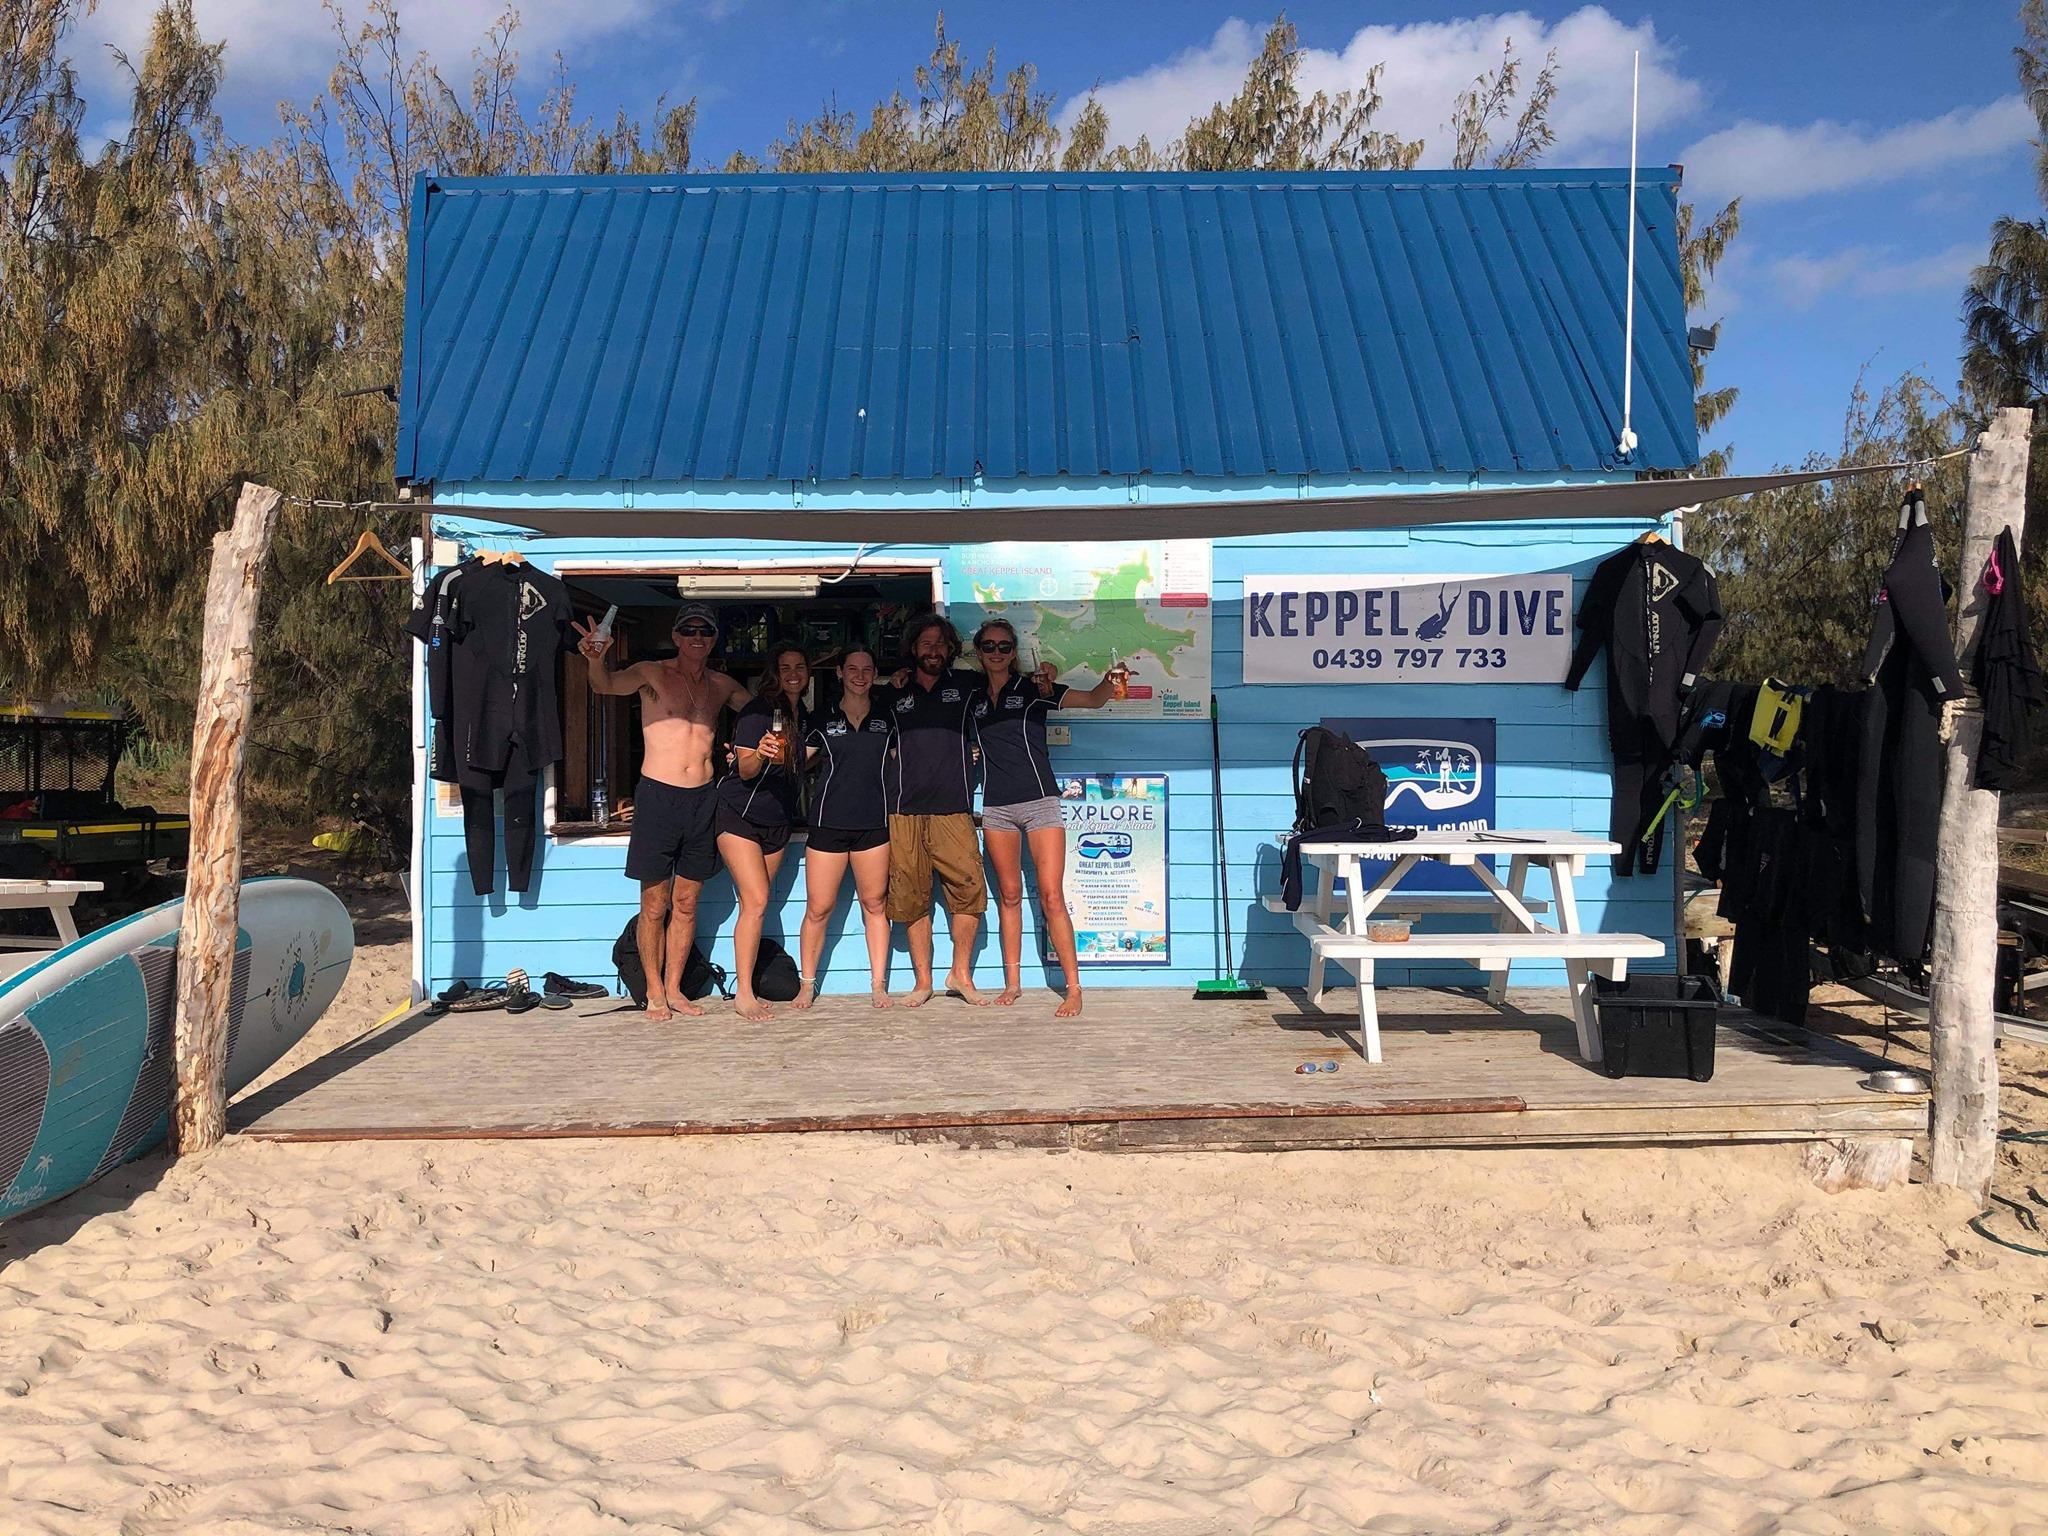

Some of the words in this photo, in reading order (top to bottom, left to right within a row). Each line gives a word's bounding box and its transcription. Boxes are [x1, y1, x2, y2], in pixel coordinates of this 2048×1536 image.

[961, 567, 987, 576] GREAT
[990, 567, 1019, 575] KEPPEL
[1021, 567, 1053, 575] ISLAND
[1250, 590, 1409, 637] KEPPEL
[1467, 589, 1565, 636] DIVE
[1652, 610, 1661, 655] ADRENALIN
[1312, 648, 1383, 669] 0439
[1393, 648, 1444, 669] 797
[1455, 648, 1507, 669] 733
[1060, 805, 1153, 821] EXPLORE
[1085, 819, 1118, 833] Keppel
[1078, 861, 1094, 869] GREAT
[1095, 861, 1112, 869] KEPPEL
[1113, 860, 1132, 868] ISLAND
